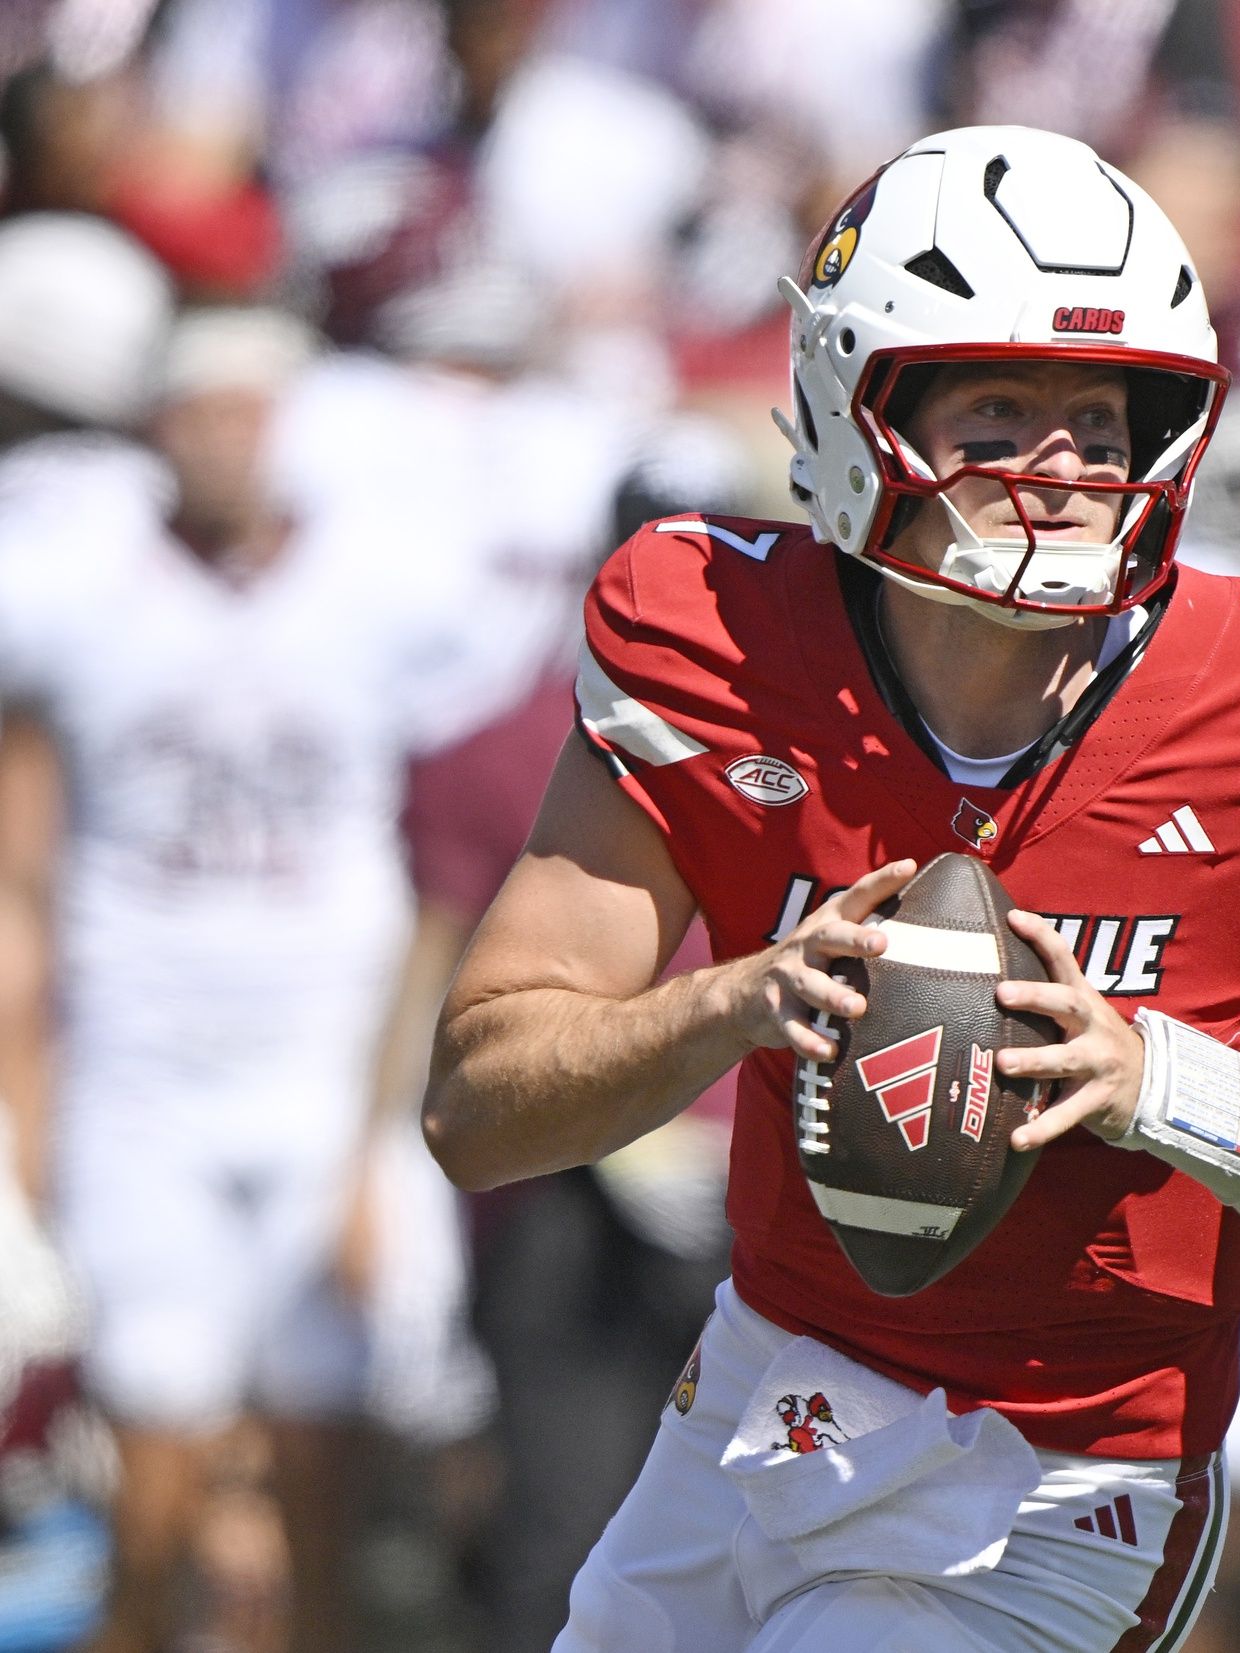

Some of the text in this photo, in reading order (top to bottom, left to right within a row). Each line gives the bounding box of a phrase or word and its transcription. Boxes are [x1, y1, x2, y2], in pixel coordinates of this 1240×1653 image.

[1052, 306, 1126, 335] CARDS
[739, 767, 797, 791] ACC
[960, 1043, 994, 1143] DIME
